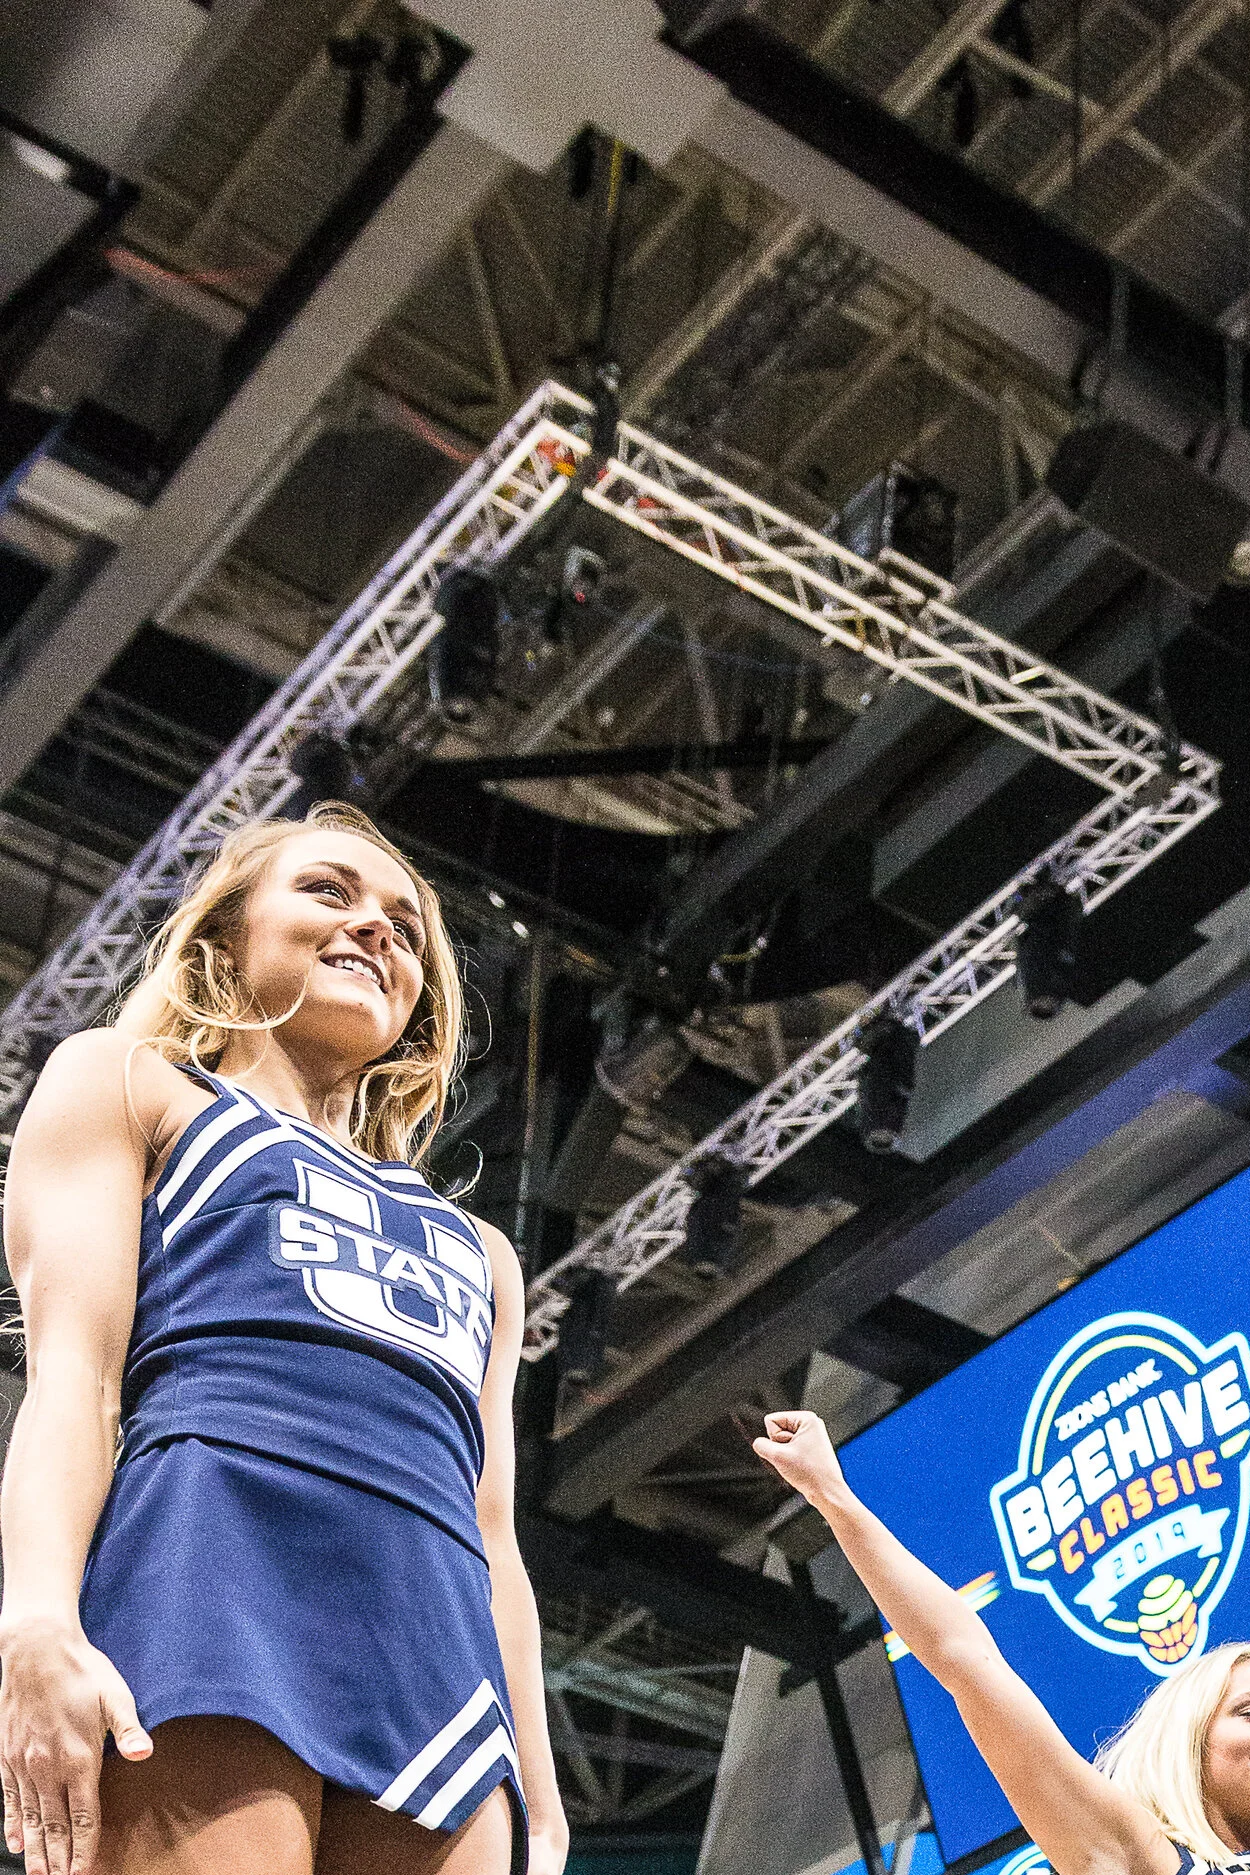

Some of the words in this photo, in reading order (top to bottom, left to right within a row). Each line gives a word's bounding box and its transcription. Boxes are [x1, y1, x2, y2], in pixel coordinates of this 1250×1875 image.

[280, 1207, 492, 1350] STATE
[1006, 1360, 1250, 1557] BEEHIVE
[1059, 1450, 1223, 1574] CLASSIC
[1112, 1521, 1187, 1579] 2019
